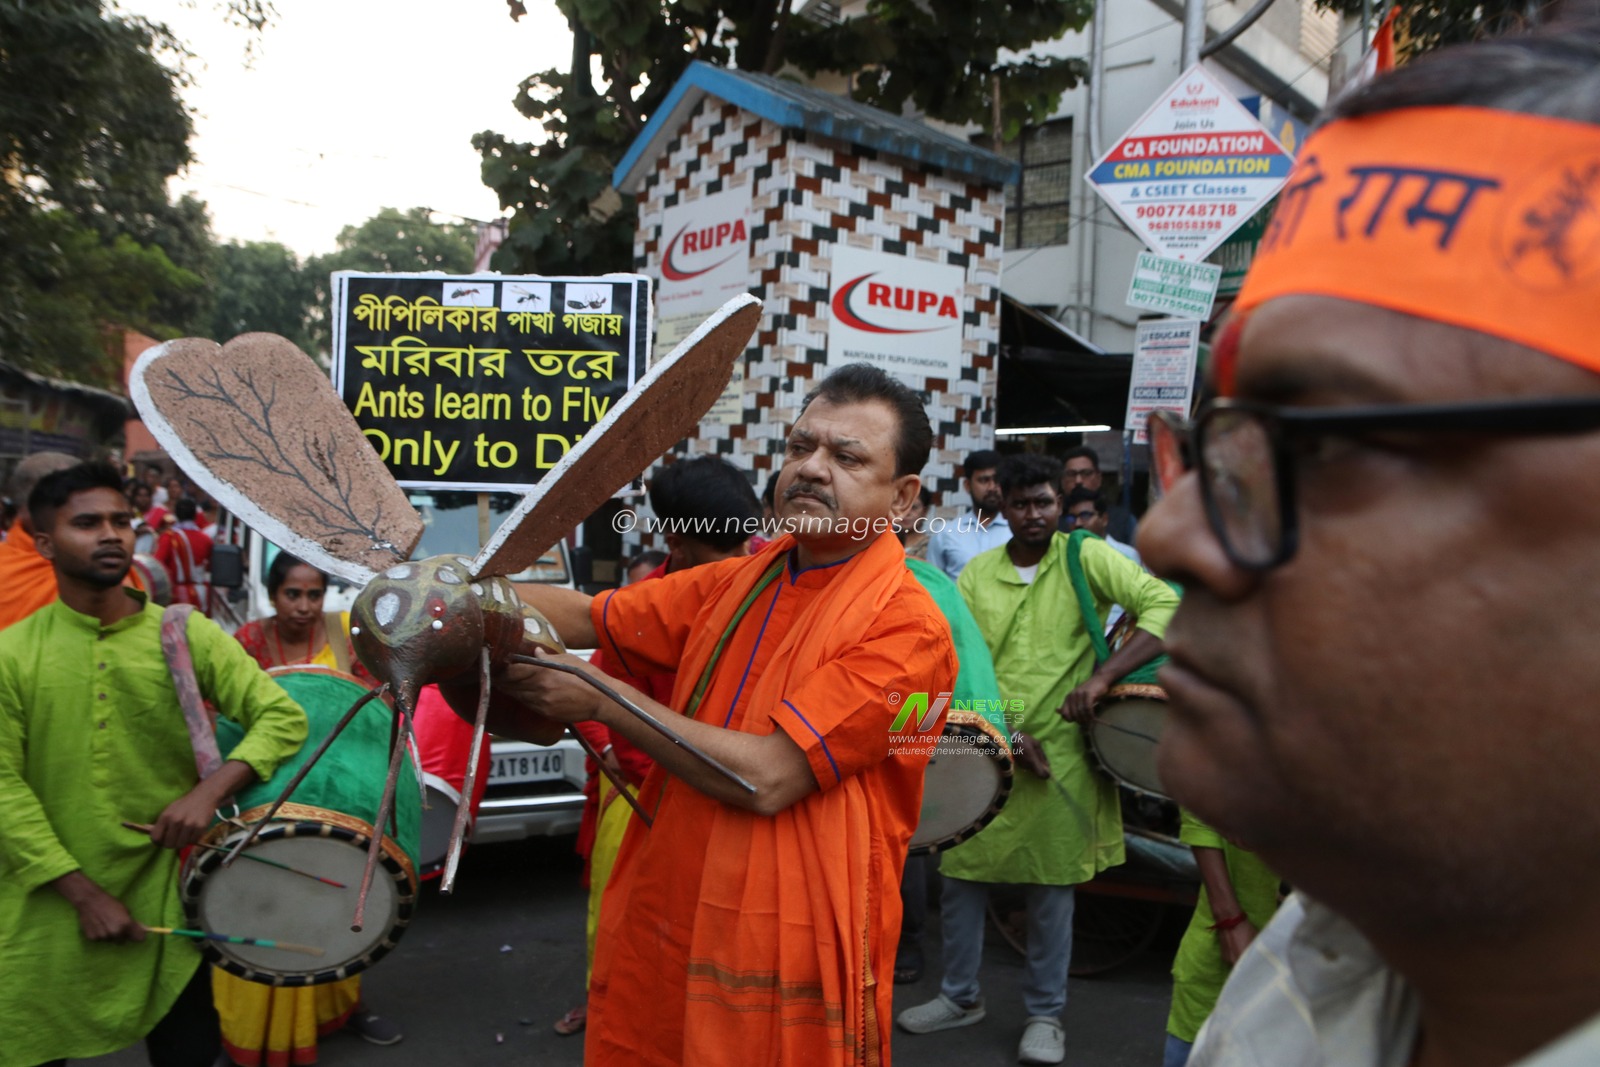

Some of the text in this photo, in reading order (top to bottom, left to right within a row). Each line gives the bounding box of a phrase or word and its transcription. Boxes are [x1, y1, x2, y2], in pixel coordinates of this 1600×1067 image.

[1174, 119, 1214, 131] Join Us
[1123, 135, 1264, 158] CA FOUNDATION
[1113, 158, 1270, 179] CMA FOUNDATION
[1130, 183, 1247, 197] & CSEET Classes
[1337, 164, 1501, 250] राम
[1136, 204, 1237, 218] 9007748718
[683, 219, 747, 256] RUPA
[1140, 255, 1217, 283] MATHEMATICS
[353, 293, 623, 336] পীপিলিকার পাখা গজায়
[867, 282, 959, 319] RUPA
[354, 336, 620, 381] মরিবার তরে
[354, 381, 610, 423] Ants learn to Fly
[361, 428, 460, 475] Only
[474, 432, 518, 468] to
